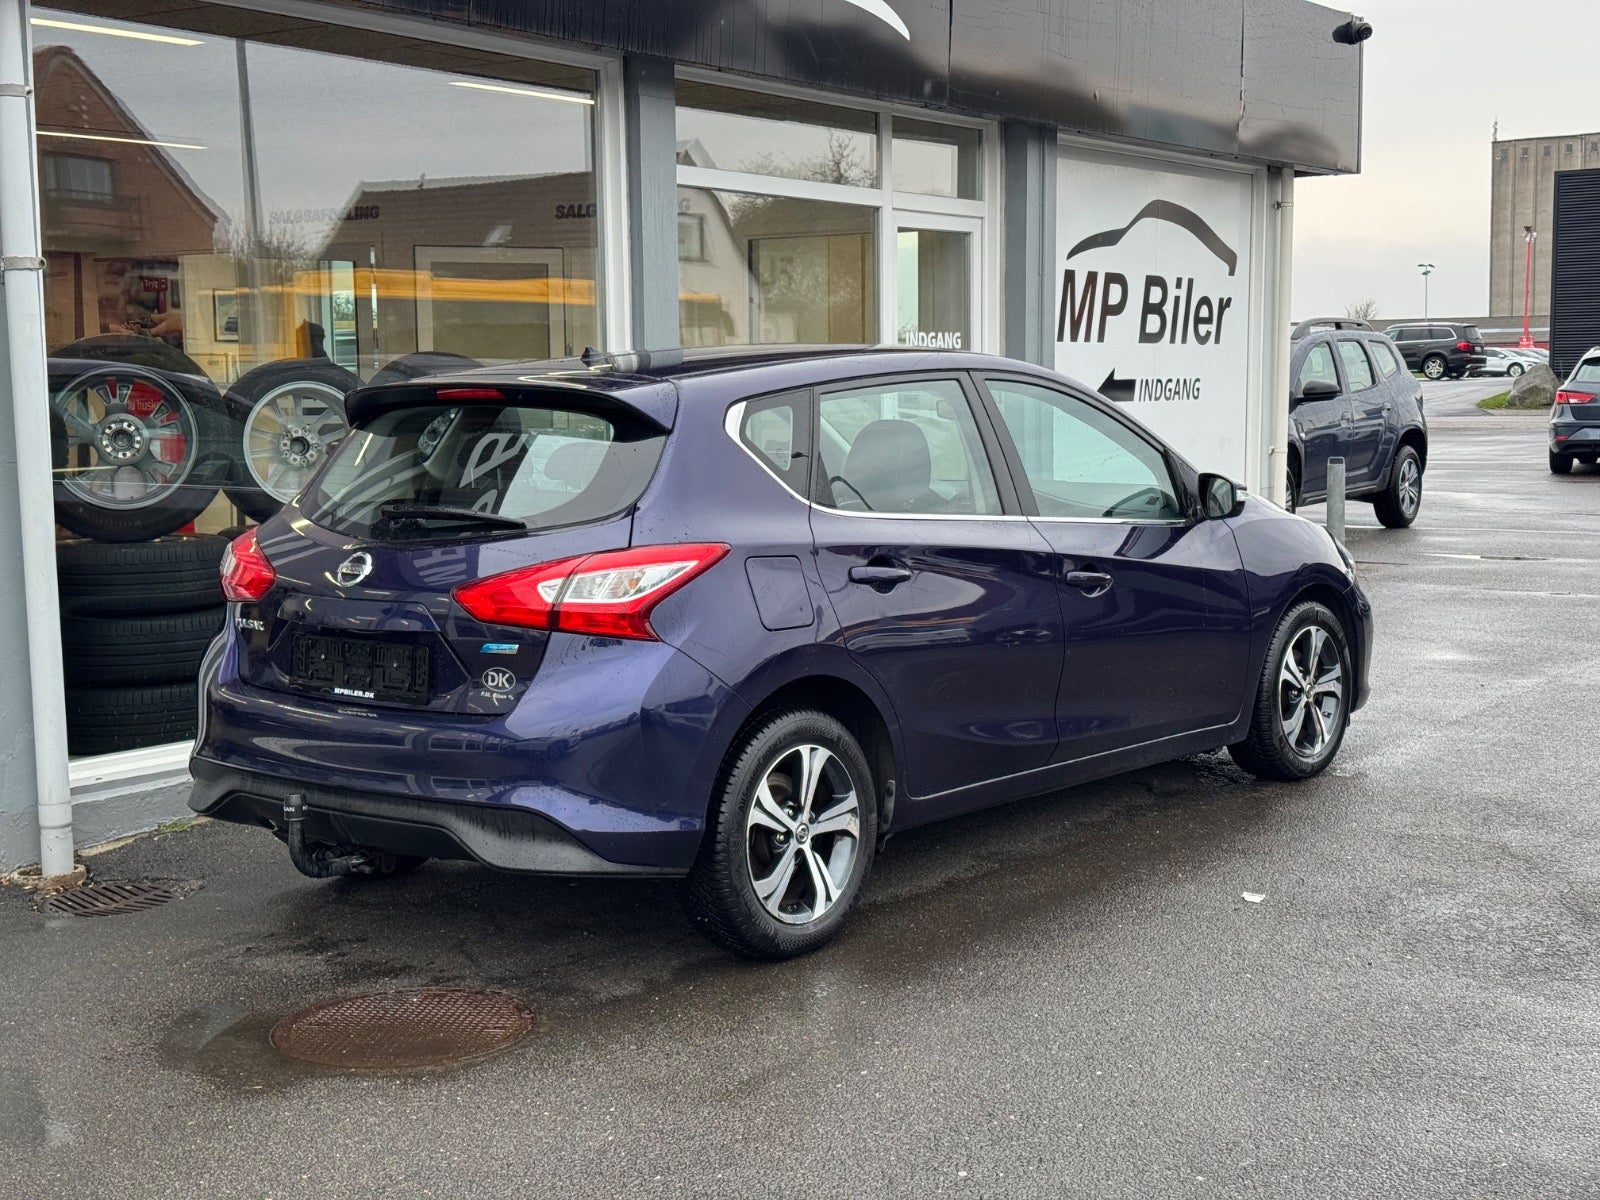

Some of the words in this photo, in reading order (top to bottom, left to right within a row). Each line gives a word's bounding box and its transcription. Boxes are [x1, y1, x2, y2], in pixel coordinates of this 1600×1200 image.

[1057, 269, 1129, 343] MP
[1138, 275, 1232, 345] Biler
[906, 331, 962, 349] INDGANG
[1138, 378, 1201, 402] INDGANG
[487, 671, 511, 689] DK
[334, 687, 375, 699] MPBILER.DK
